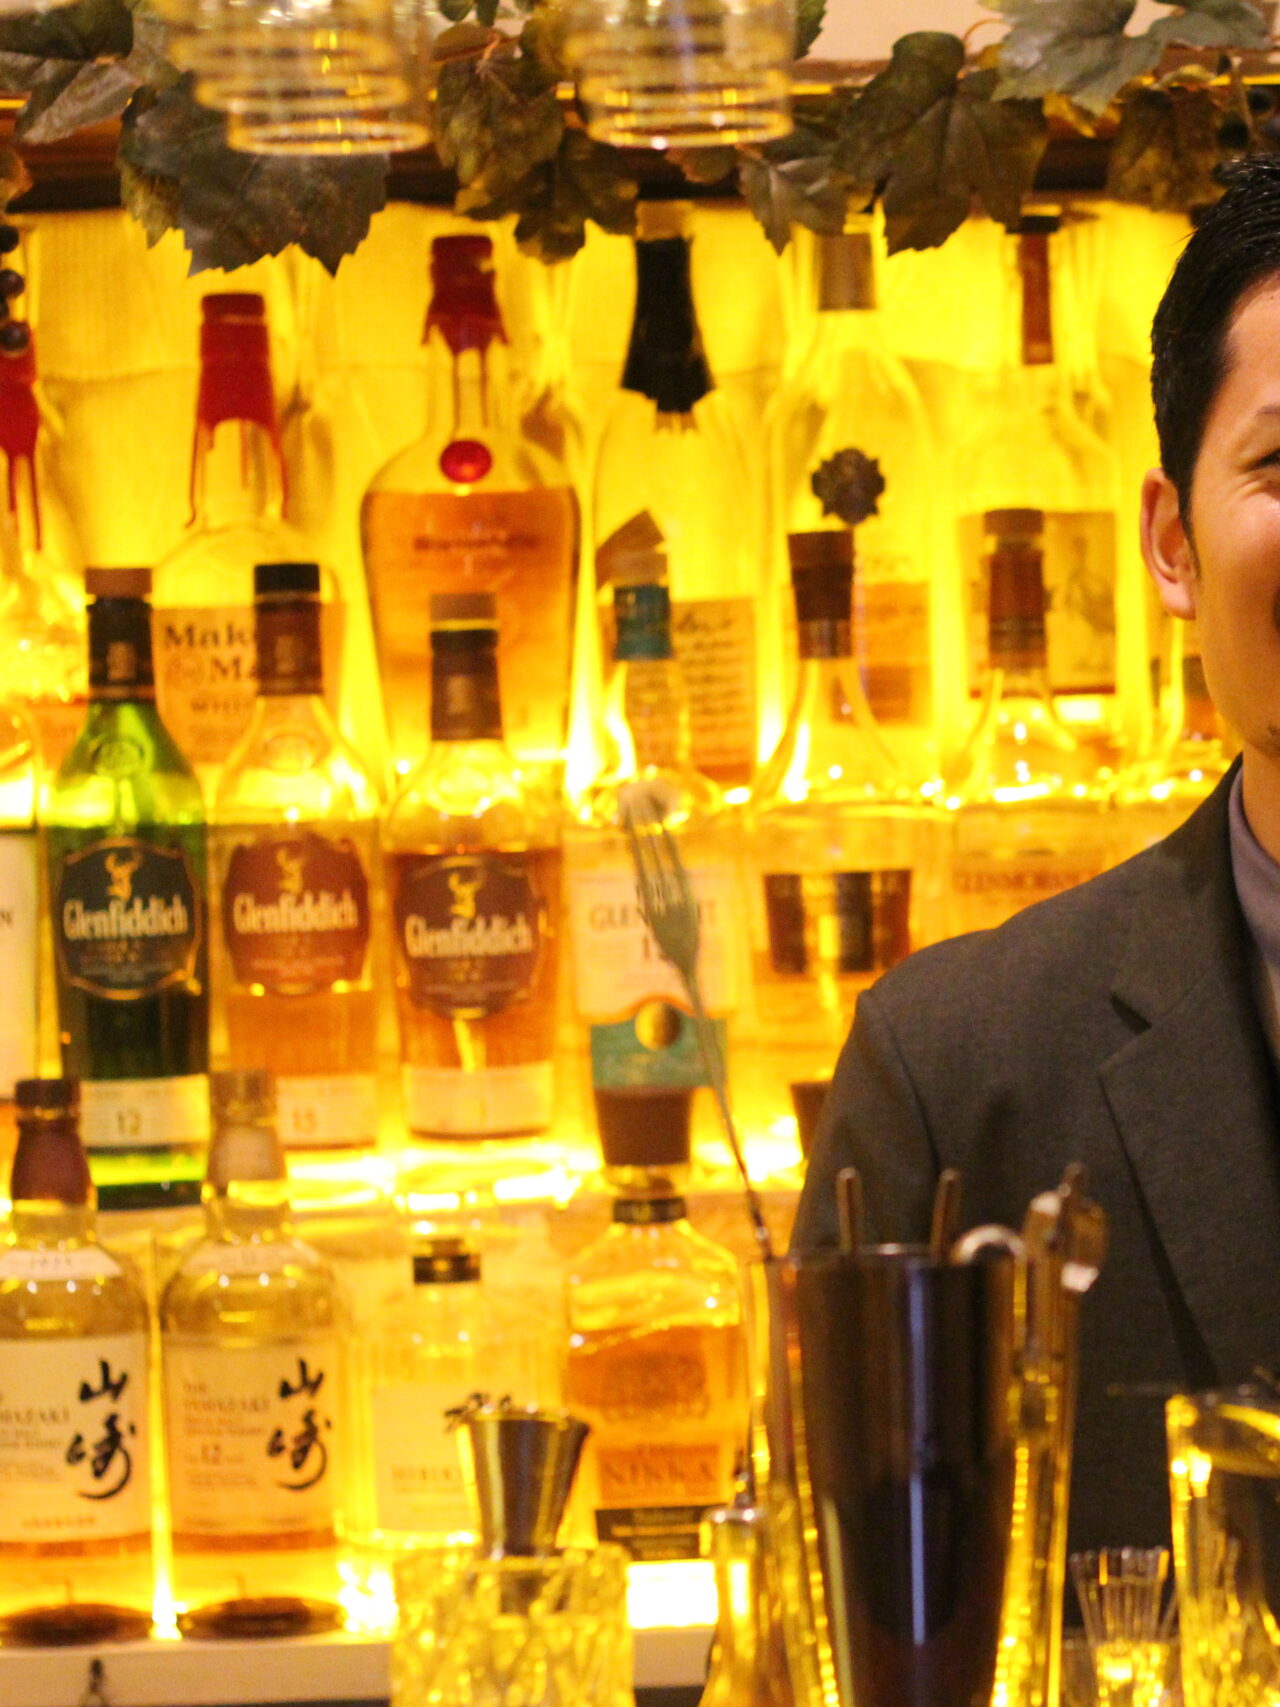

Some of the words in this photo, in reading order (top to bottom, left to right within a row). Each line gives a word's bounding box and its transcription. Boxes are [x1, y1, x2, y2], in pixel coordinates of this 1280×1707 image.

[62, 893, 189, 941] Glenfiddich
[232, 888, 359, 934] Glenfiddich
[404, 912, 533, 959] Glenfiddich
[116, 1108, 142, 1136] 12
[66, 1356, 136, 1501] 山崎
[265, 1356, 332, 1491] 山崎
